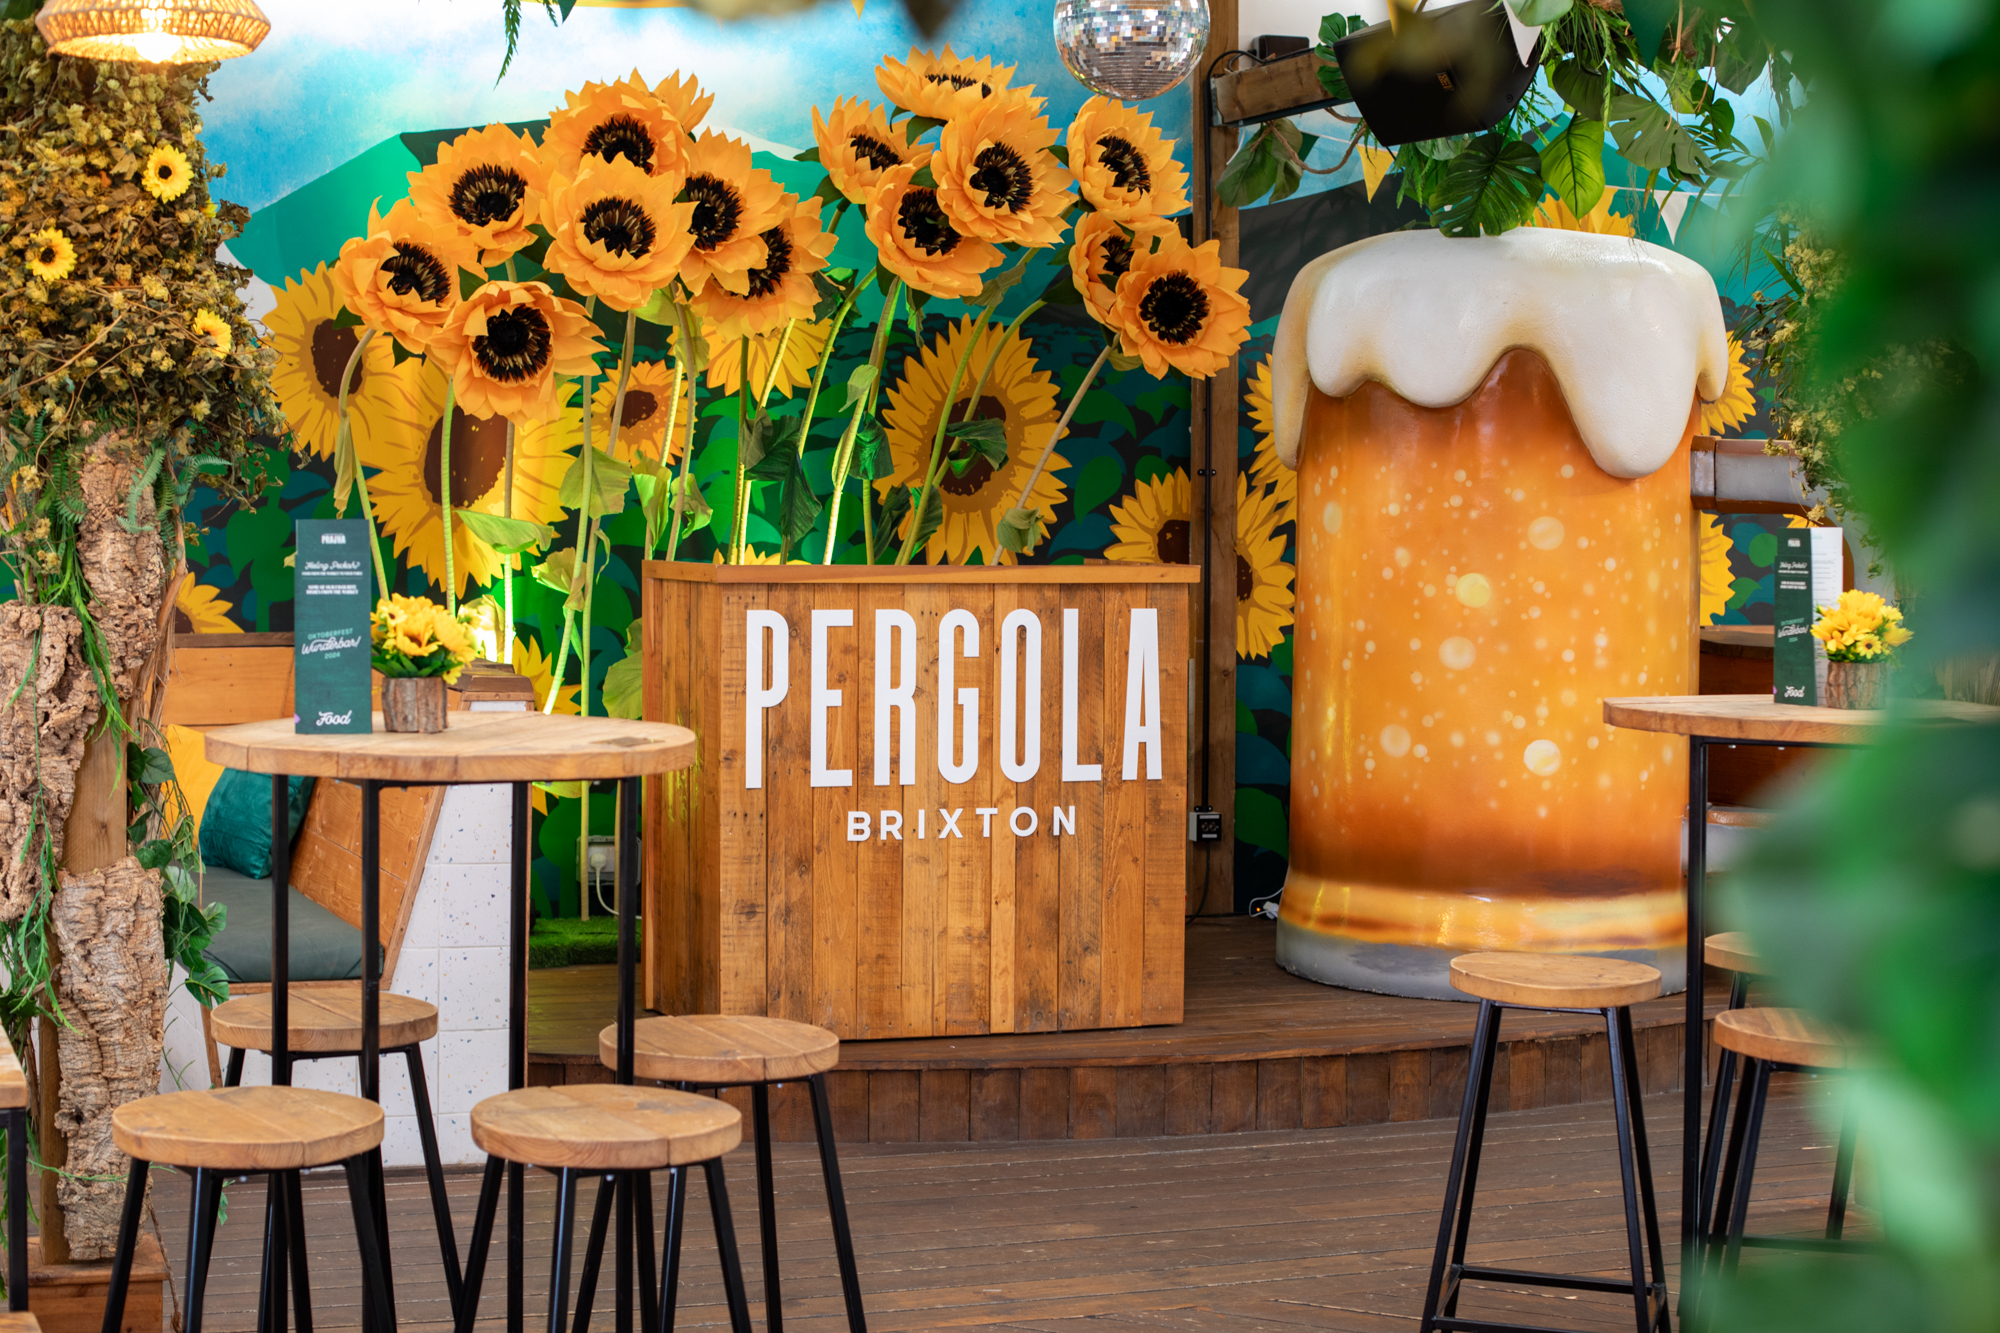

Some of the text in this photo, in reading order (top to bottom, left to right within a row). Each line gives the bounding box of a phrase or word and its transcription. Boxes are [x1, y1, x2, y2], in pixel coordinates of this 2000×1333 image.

[307, 628, 353, 640] OKTOBERFEST
[301, 636, 362, 655] Wunderbar!
[324, 651, 341, 659] 2024
[745, 607, 1162, 789] PERGOLA
[1784, 685, 1805, 698] Food
[315, 709, 353, 726] Food
[847, 805, 1076, 842] BRIXTON
